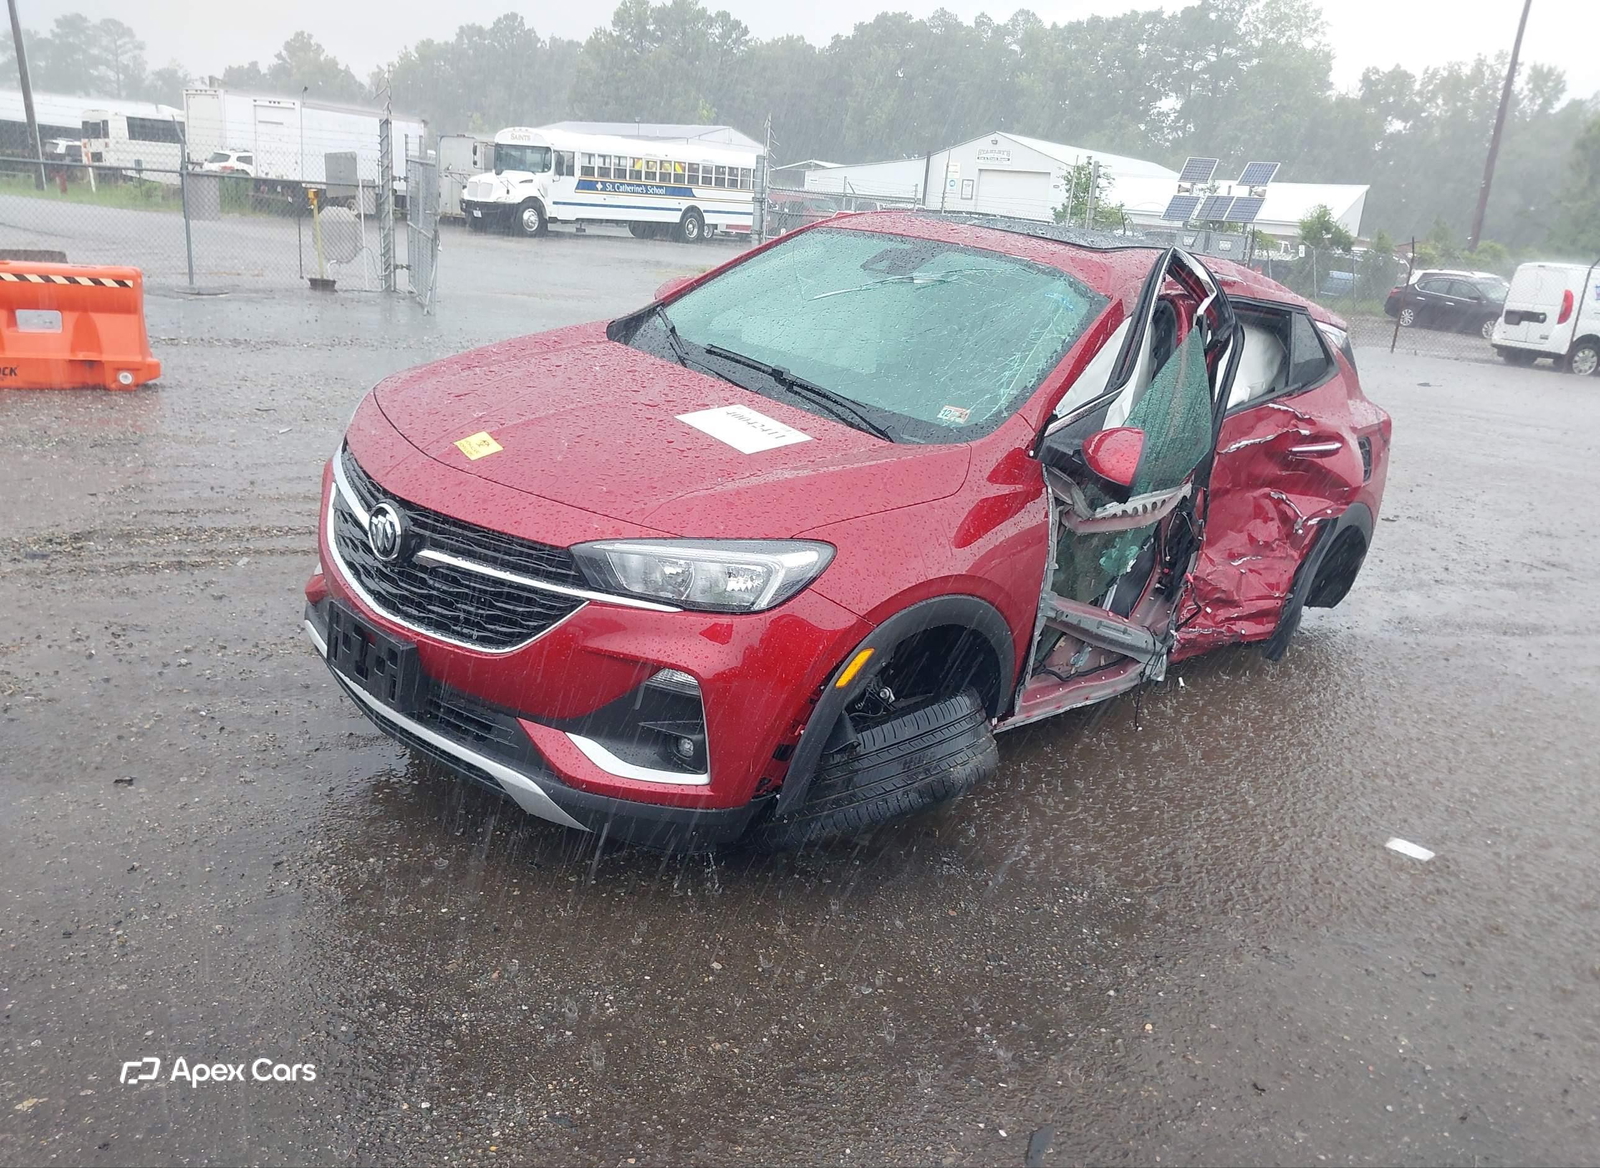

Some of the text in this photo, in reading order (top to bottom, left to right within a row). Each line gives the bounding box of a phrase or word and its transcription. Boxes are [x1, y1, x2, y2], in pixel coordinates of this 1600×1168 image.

[615, 183, 646, 193] Catherine's
[647, 185, 666, 195] School
[0, 367, 18, 377] CK
[941, 408, 952, 418] 12
